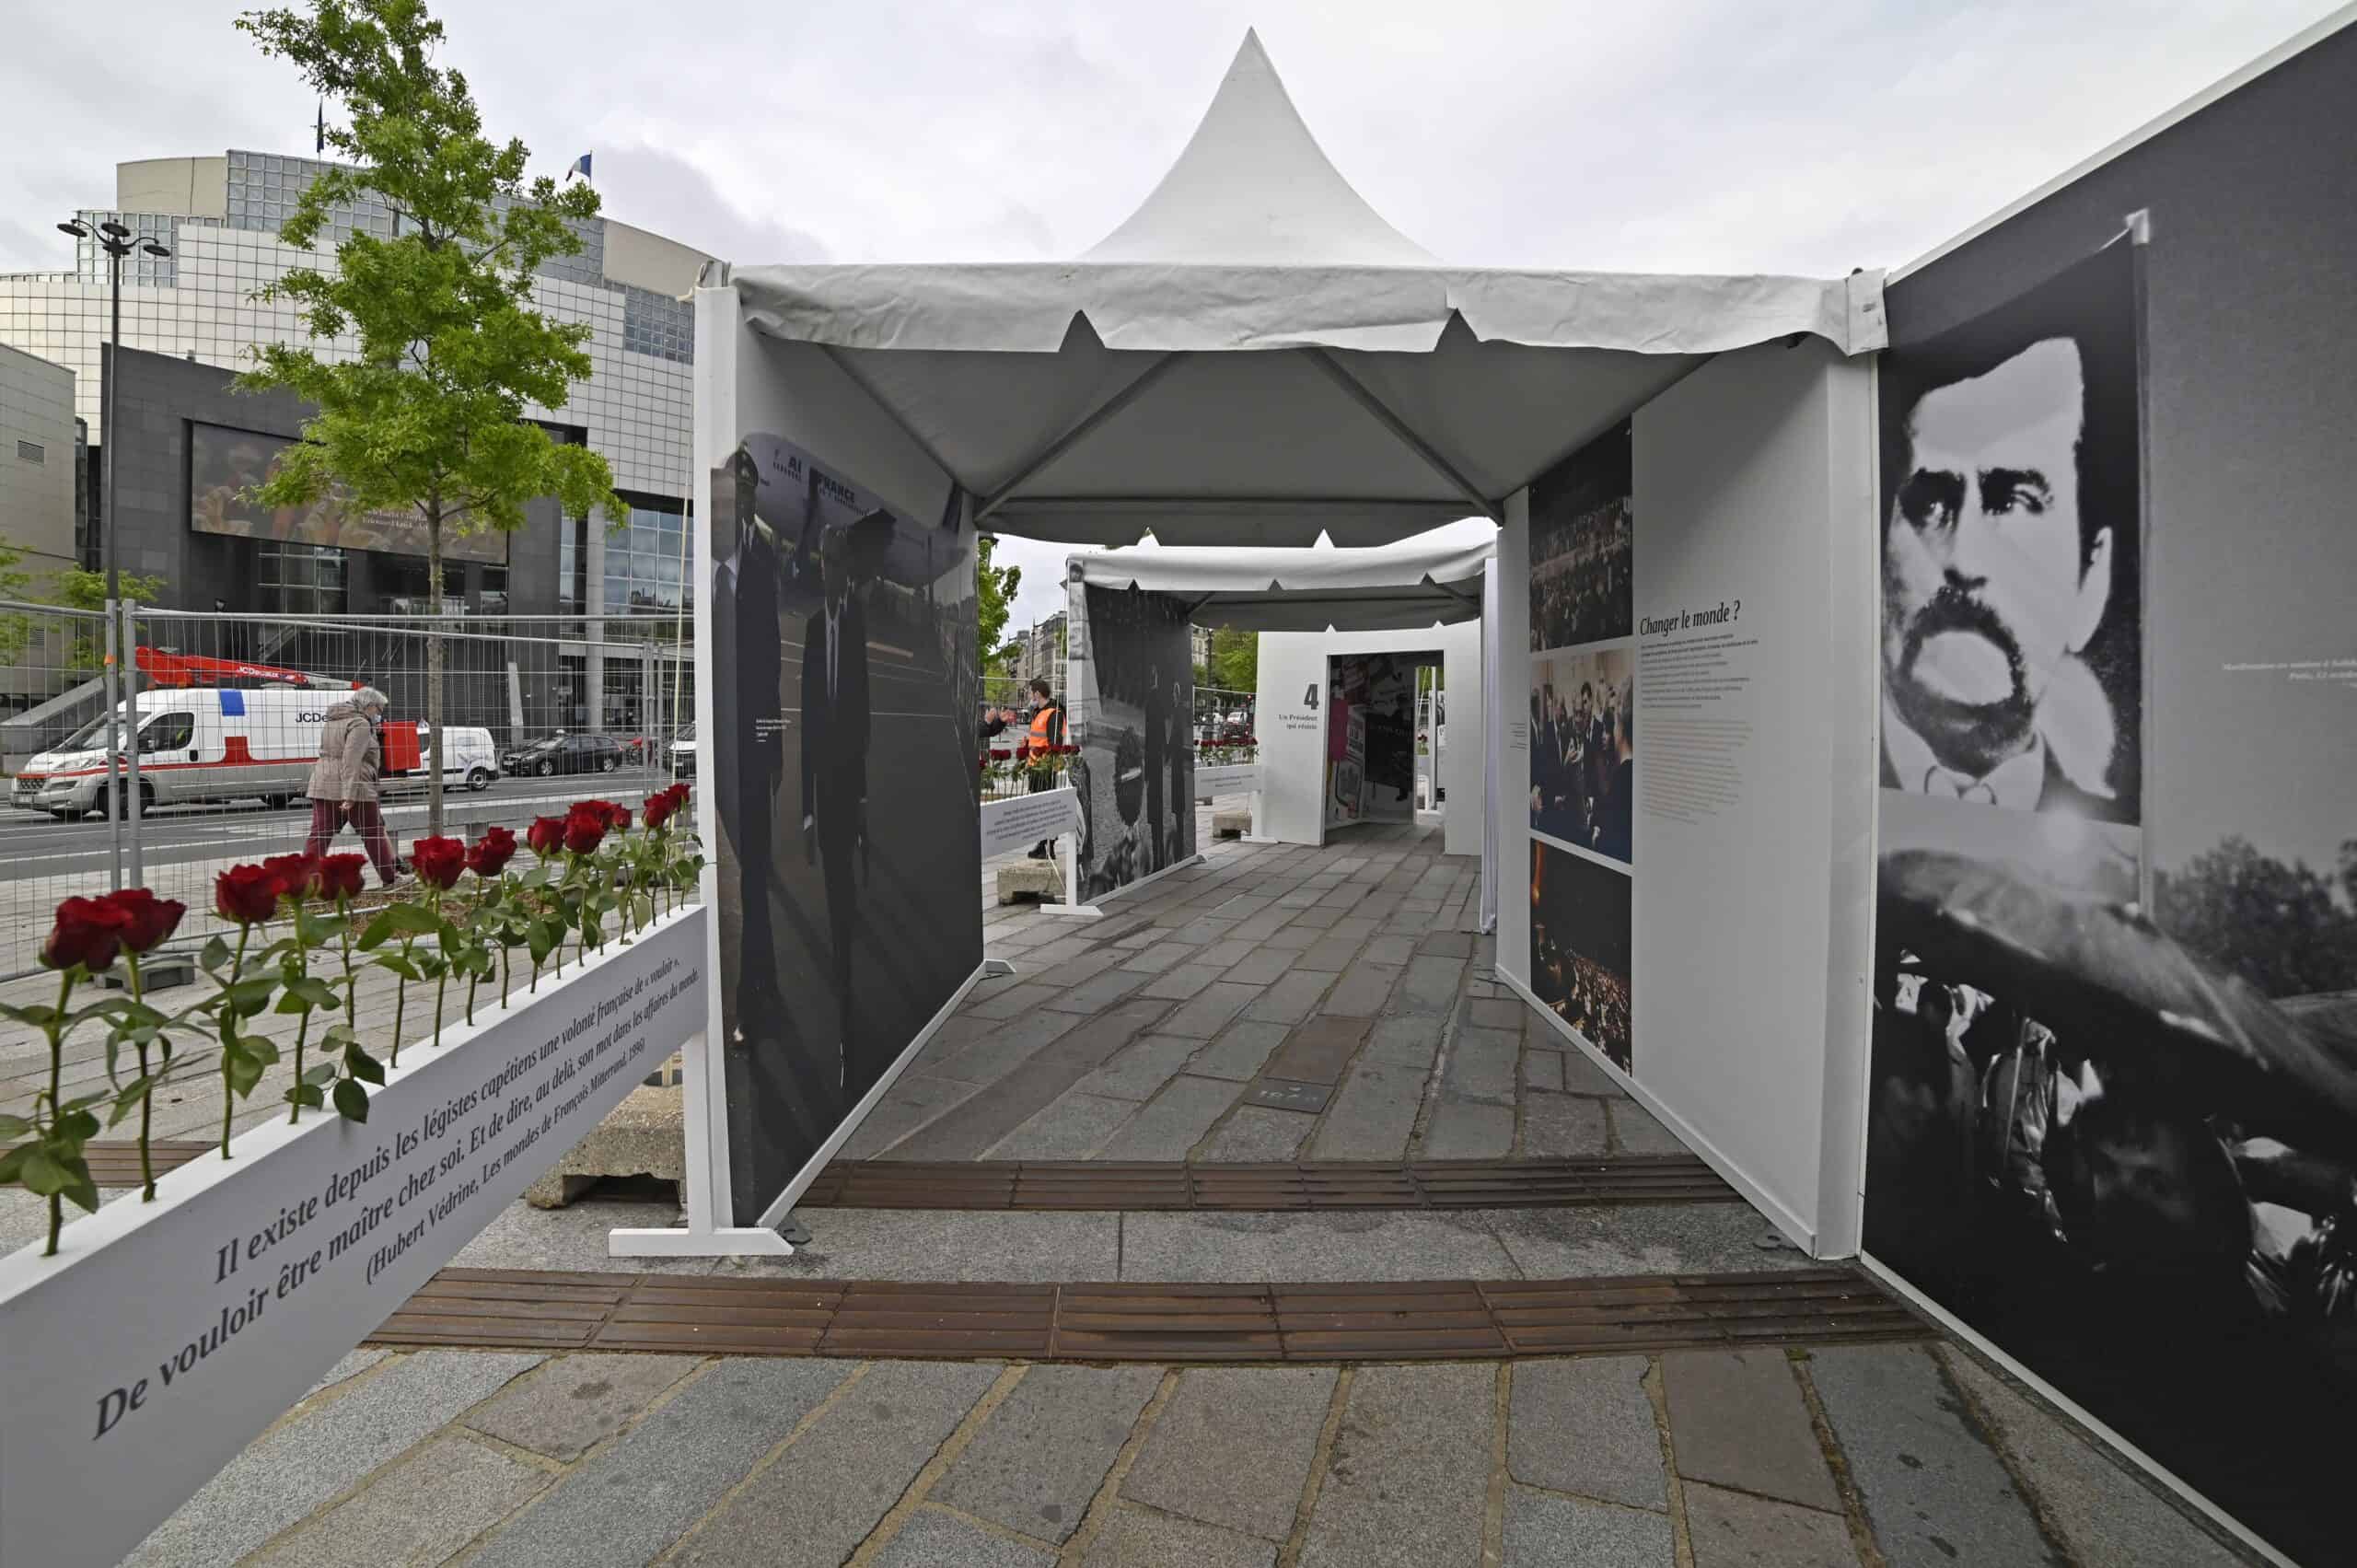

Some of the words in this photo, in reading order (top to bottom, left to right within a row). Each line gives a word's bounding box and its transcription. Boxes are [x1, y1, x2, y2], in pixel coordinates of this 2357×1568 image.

[1304, 683, 1318, 710] 4
[1640, 616, 1679, 637] Changer
[1680, 610, 1690, 630] le
[1692, 601, 1730, 627] monde
[1733, 599, 1741, 621] ?
[92, 1378, 149, 1441] De
[159, 1286, 270, 1387] vouloir
[277, 1249, 322, 1300] être
[329, 1197, 394, 1262] maître
[399, 1164, 436, 1207] chez
[439, 1139, 465, 1177] soi.
[470, 1125, 486, 1155] Et
[489, 1111, 504, 1140] de
[506, 1095, 533, 1125] dire,
[536, 1079, 550, 1103] au
[552, 1058, 575, 1090] delà,
[577, 1048, 594, 1071] son
[596, 1031, 612, 1057] mot
[612, 1019, 632, 1043] dans
[633, 1009, 643, 1029] les
[644, 993, 669, 1023] affaires
[669, 981, 679, 1000] du
[215, 1237, 239, 1284] Il
[248, 1196, 318, 1260] existe
[325, 1145, 390, 1208] depuis
[395, 1128, 419, 1162] les
[424, 1090, 478, 1142] légistes
[481, 1050, 538, 1101] capétiens
[540, 1035, 560, 1061] une
[562, 1005, 596, 1045] volonté
[597, 986, 633, 1027] française
[634, 977, 644, 994] de
[650, 958, 673, 983] vouloir
[366, 1219, 424, 1285] (Hubert
[428, 1179, 480, 1229] Védrine,
[482, 1157, 501, 1185] Les
[504, 1127, 540, 1167] mondes
[541, 1114, 552, 1135] de
[554, 1084, 589, 1123] François
